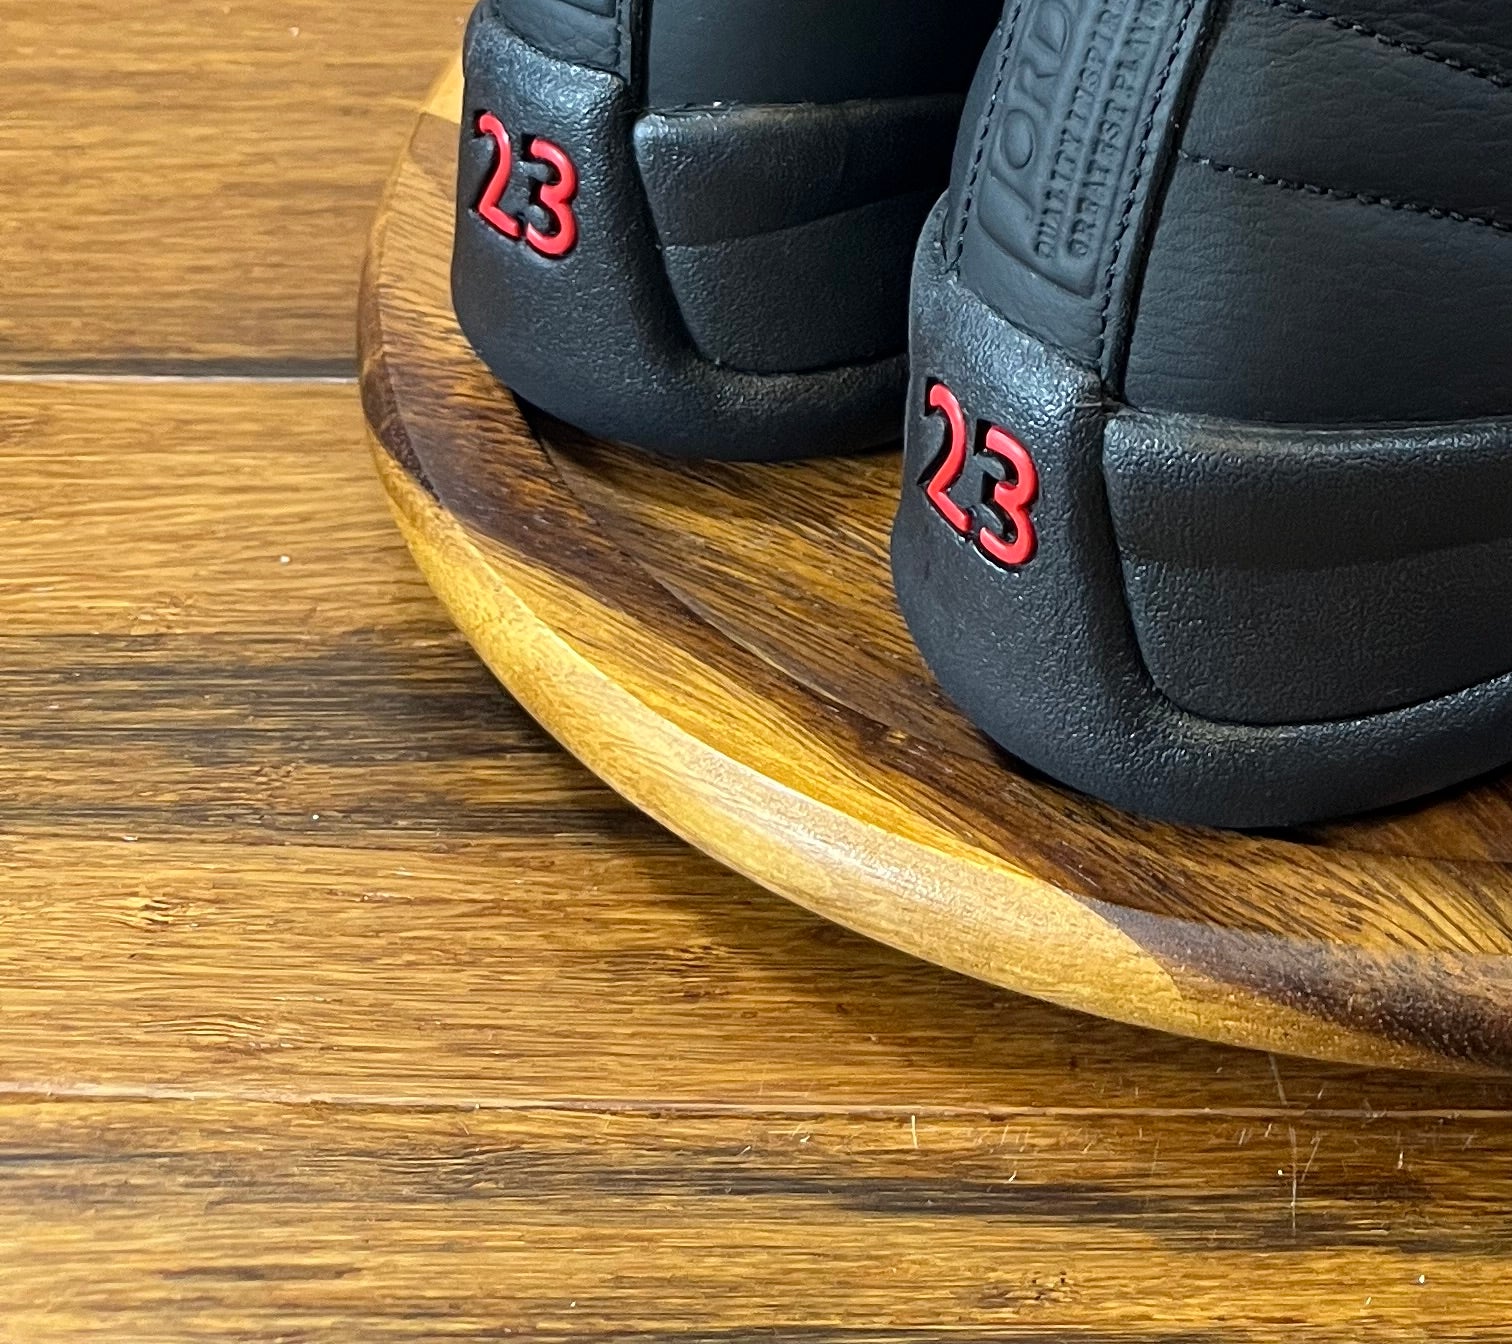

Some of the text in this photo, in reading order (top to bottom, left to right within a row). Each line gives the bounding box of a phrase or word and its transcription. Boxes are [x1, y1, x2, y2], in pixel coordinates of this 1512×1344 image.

[475, 110, 578, 257] 23
[1033, 128, 1083, 258] QUALITY
[1066, 98, 1128, 258] GREATEST
[924, 380, 1038, 566] 23
